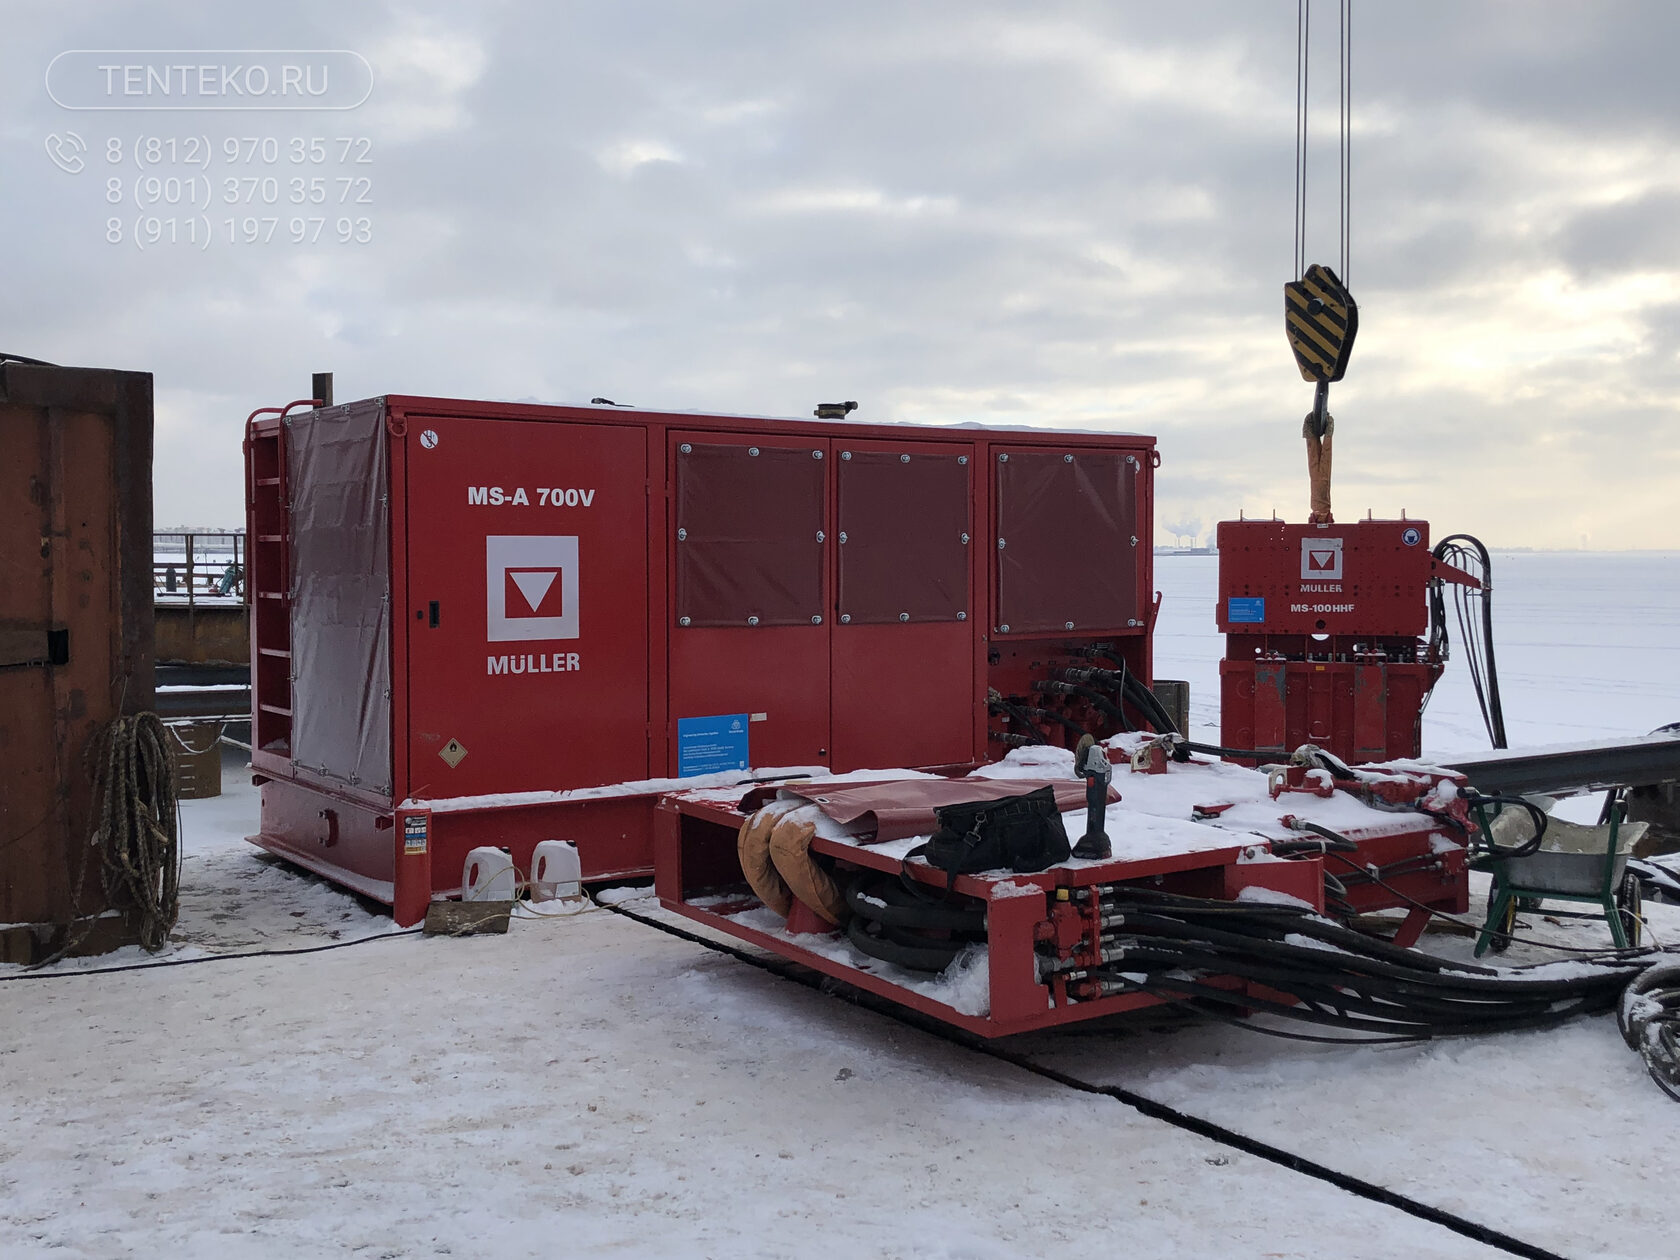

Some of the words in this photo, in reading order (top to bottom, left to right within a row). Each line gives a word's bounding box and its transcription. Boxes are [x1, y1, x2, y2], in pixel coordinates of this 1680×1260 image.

[467, 487, 529, 505] MS-A
[537, 488, 595, 506] 700V
[487, 652, 580, 676] MÜLLER
